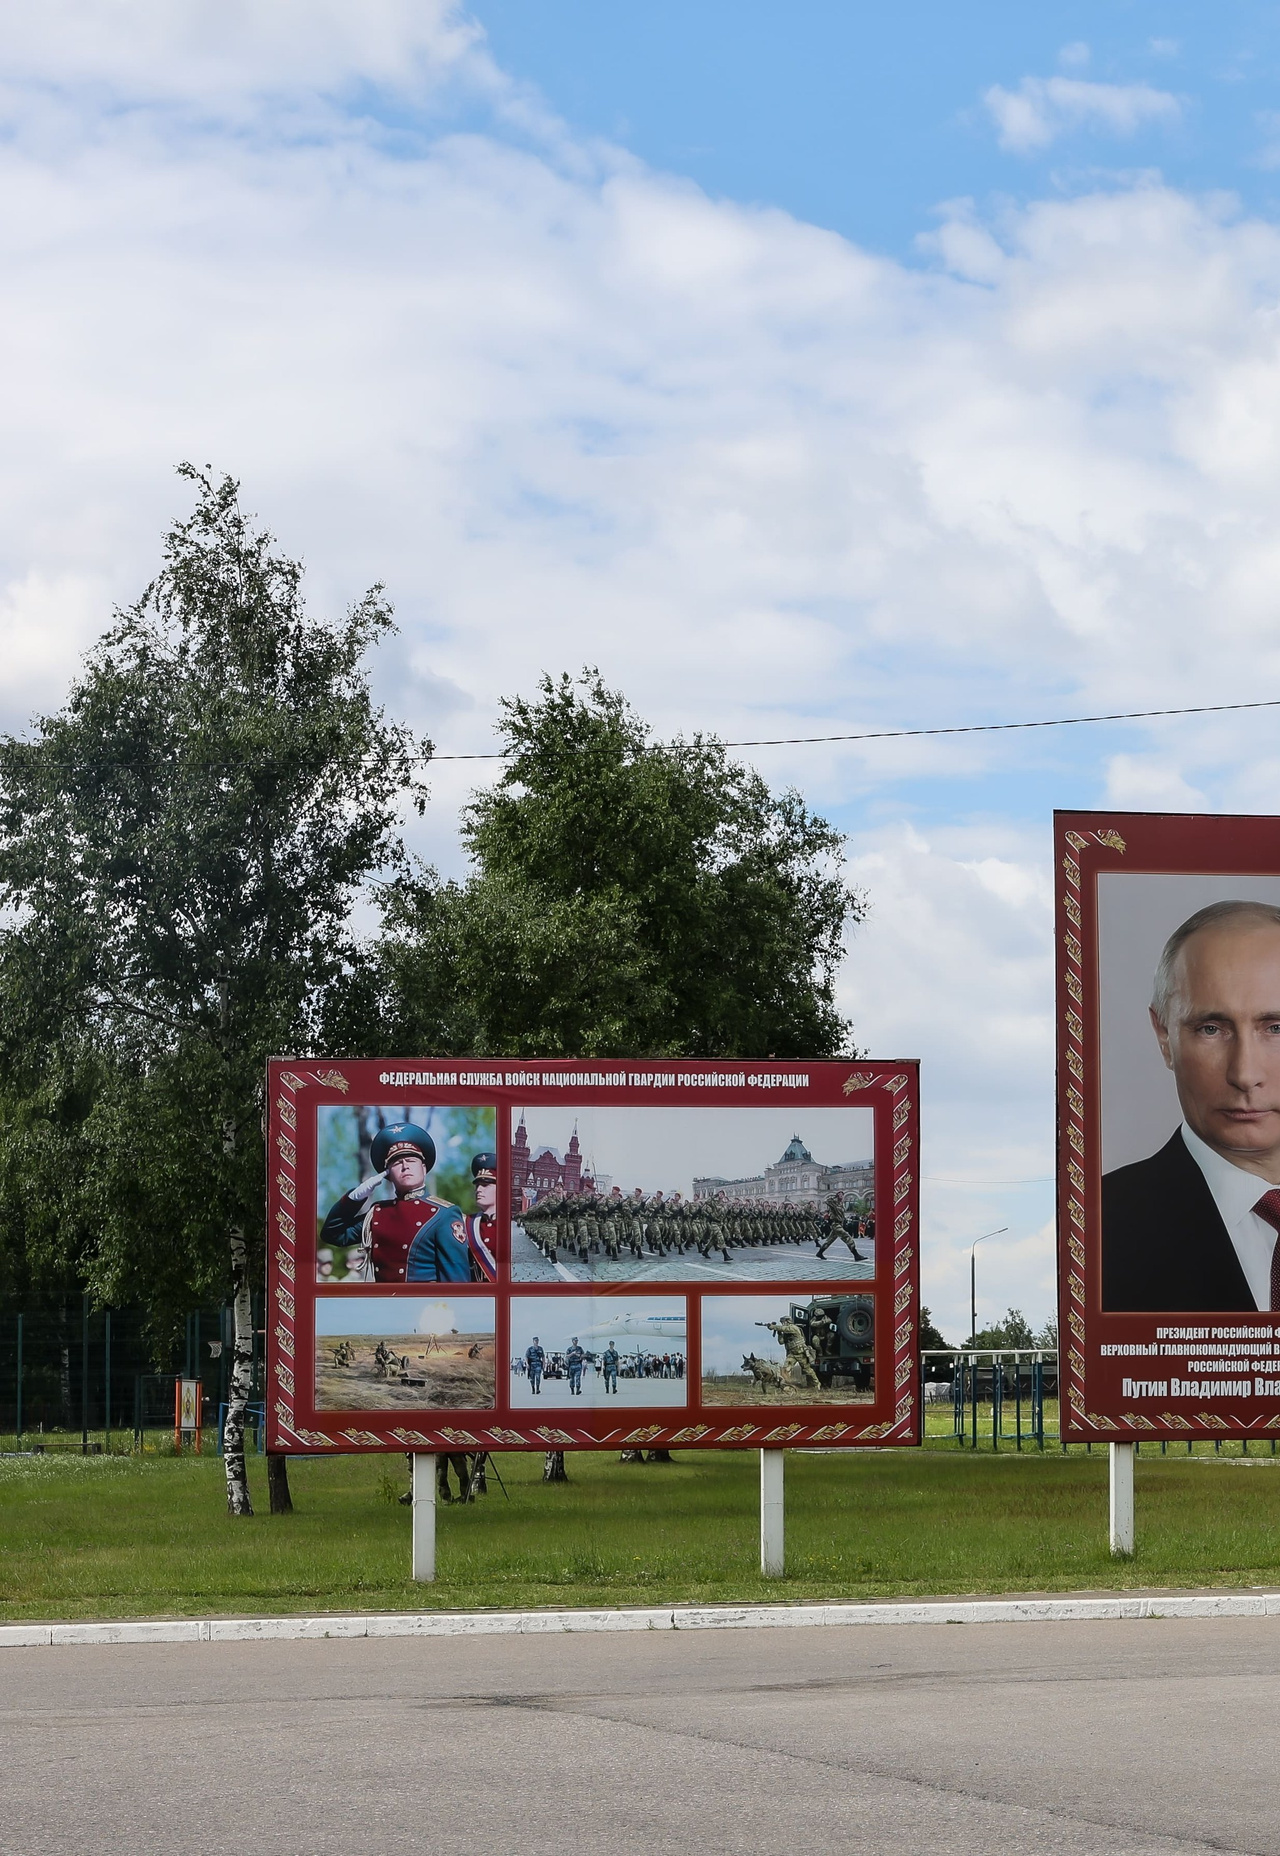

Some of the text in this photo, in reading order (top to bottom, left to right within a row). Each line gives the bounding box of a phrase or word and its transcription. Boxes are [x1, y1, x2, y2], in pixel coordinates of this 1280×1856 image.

[379, 1071, 810, 1089] ФЕДЕРАЛЬНАЯ СЛУЖБА ВОЙСК НАЦИОНАЛЬНОЙ ГВАРДИИ РОССИЙСКОЙ ФЕДЕРАЦИИ
[1156, 1327, 1210, 1341] ПРЕЗИДЕНТ
[1211, 1325, 1273, 1339] РОССИЙСКОЙ
[1100, 1342, 1158, 1356] ВЕРХОВНЫЙ
[1159, 1342, 1272, 1357] ГЛАВНОКОМАНДУЮЩИЙ
[1187, 1359, 1250, 1373] РОССИЙСКОЙ
[1122, 1377, 1168, 1399] Путин
[1170, 1377, 1252, 1399] Владимир
